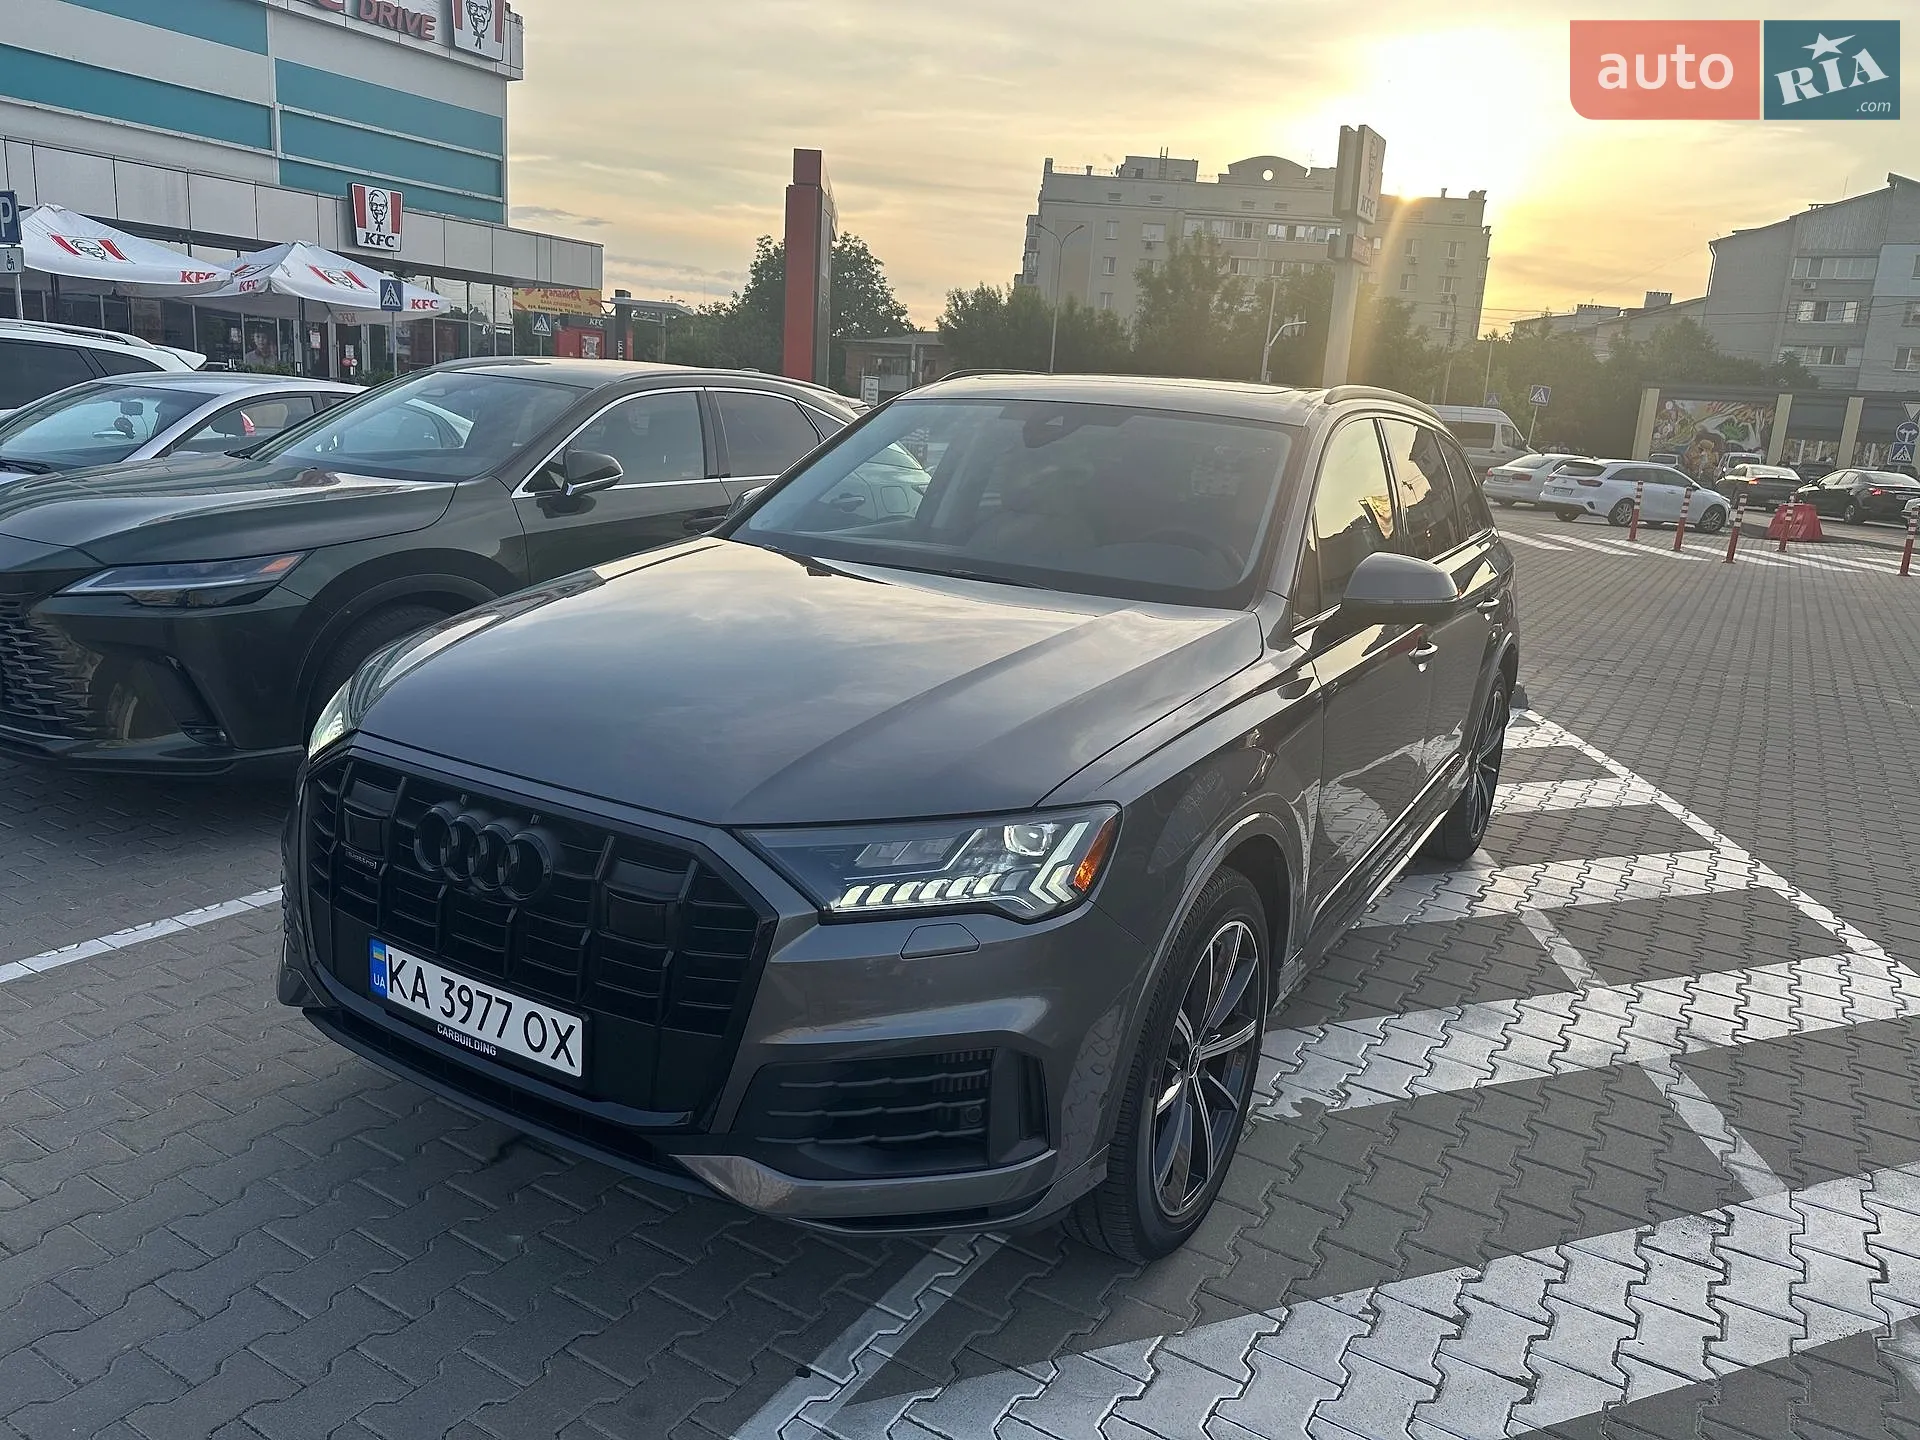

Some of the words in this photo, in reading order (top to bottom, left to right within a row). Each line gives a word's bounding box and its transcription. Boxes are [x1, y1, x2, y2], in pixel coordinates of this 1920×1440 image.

[358, 0, 436, 41] DRIVE
[1360, 195, 1375, 217] KFC
[0, 196, 13, 238] P
[364, 232, 395, 247] KFC
[239, 279, 259, 292] KFC
[411, 299, 439, 310] KFC
[589, 318, 604, 326] KFC
[373, 973, 386, 989] UA
[387, 953, 430, 1009] KA
[440, 975, 513, 1039] 3977
[523, 1010, 576, 1068] OX
[437, 1023, 497, 1056] CARBUILDING
